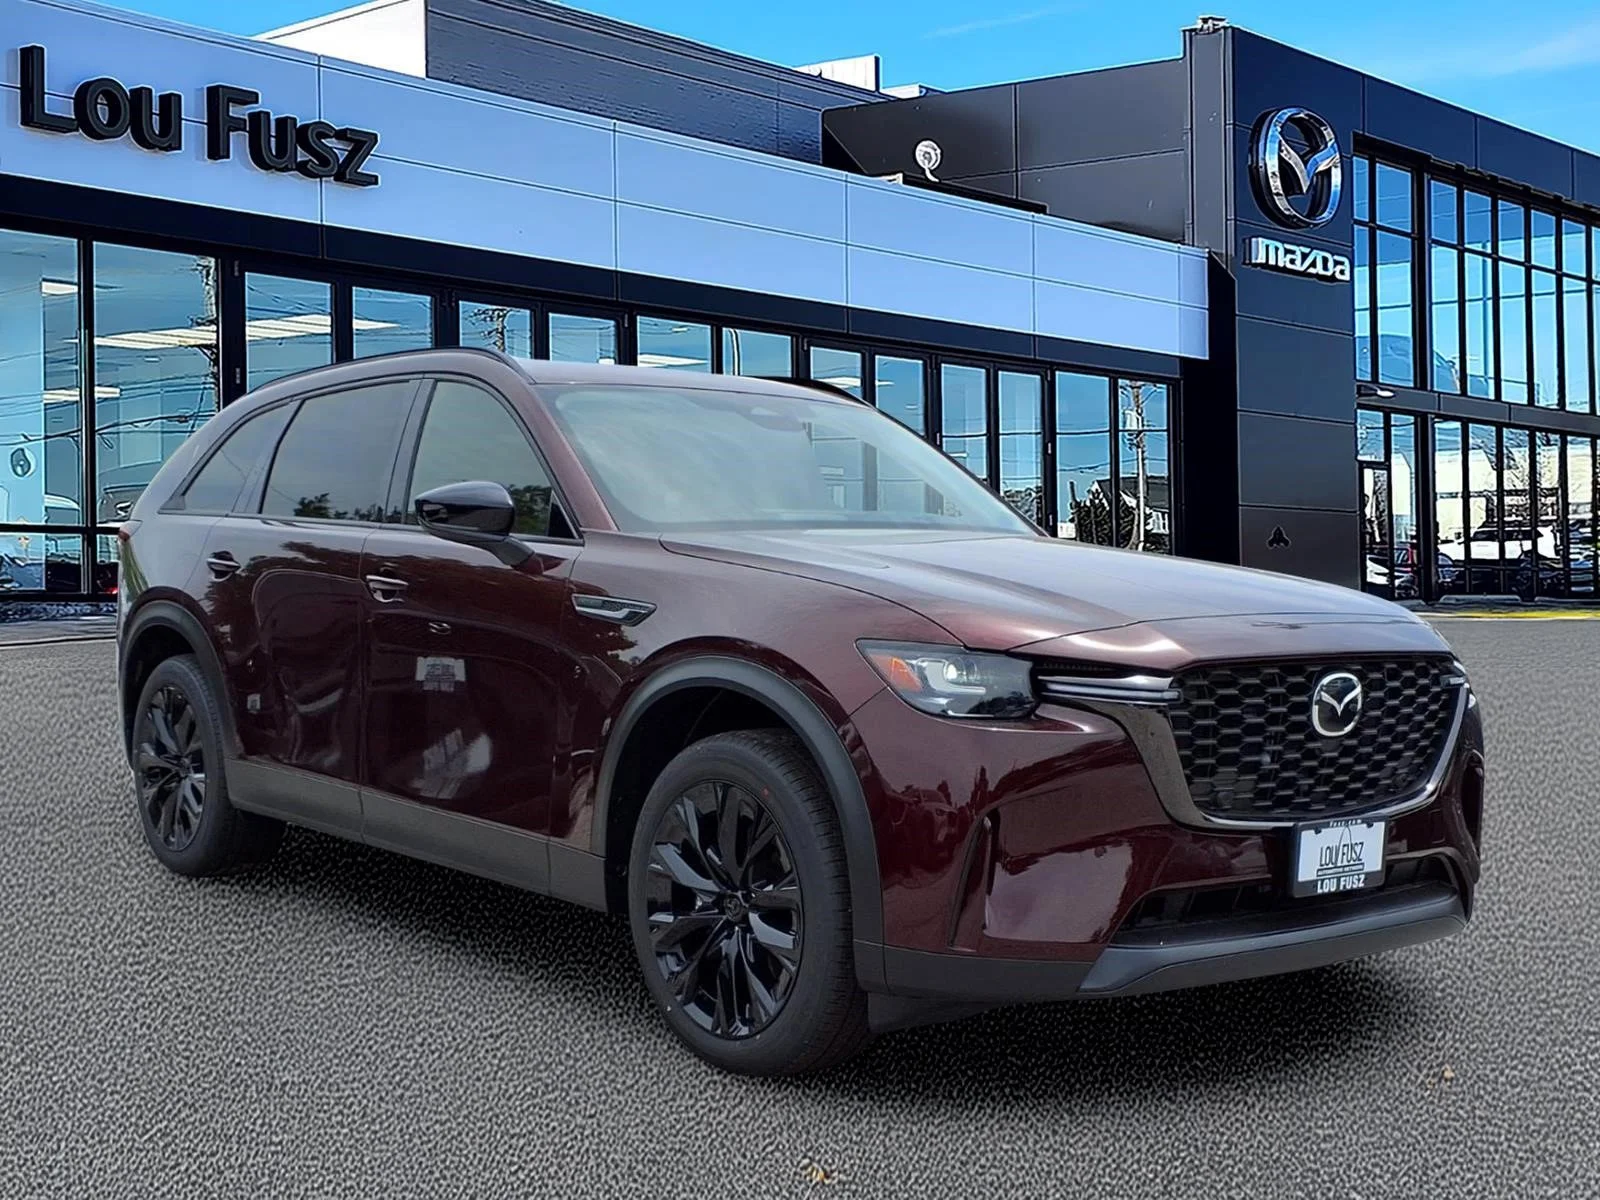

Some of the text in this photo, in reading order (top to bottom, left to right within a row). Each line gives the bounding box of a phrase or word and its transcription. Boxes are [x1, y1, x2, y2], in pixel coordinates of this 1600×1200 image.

[19, 44, 379, 186] Lou Fusz
[1248, 236, 1351, 281] mazda
[1320, 841, 1364, 867] LOU FUSZ
[1317, 875, 1365, 894] LOU FUSZ
